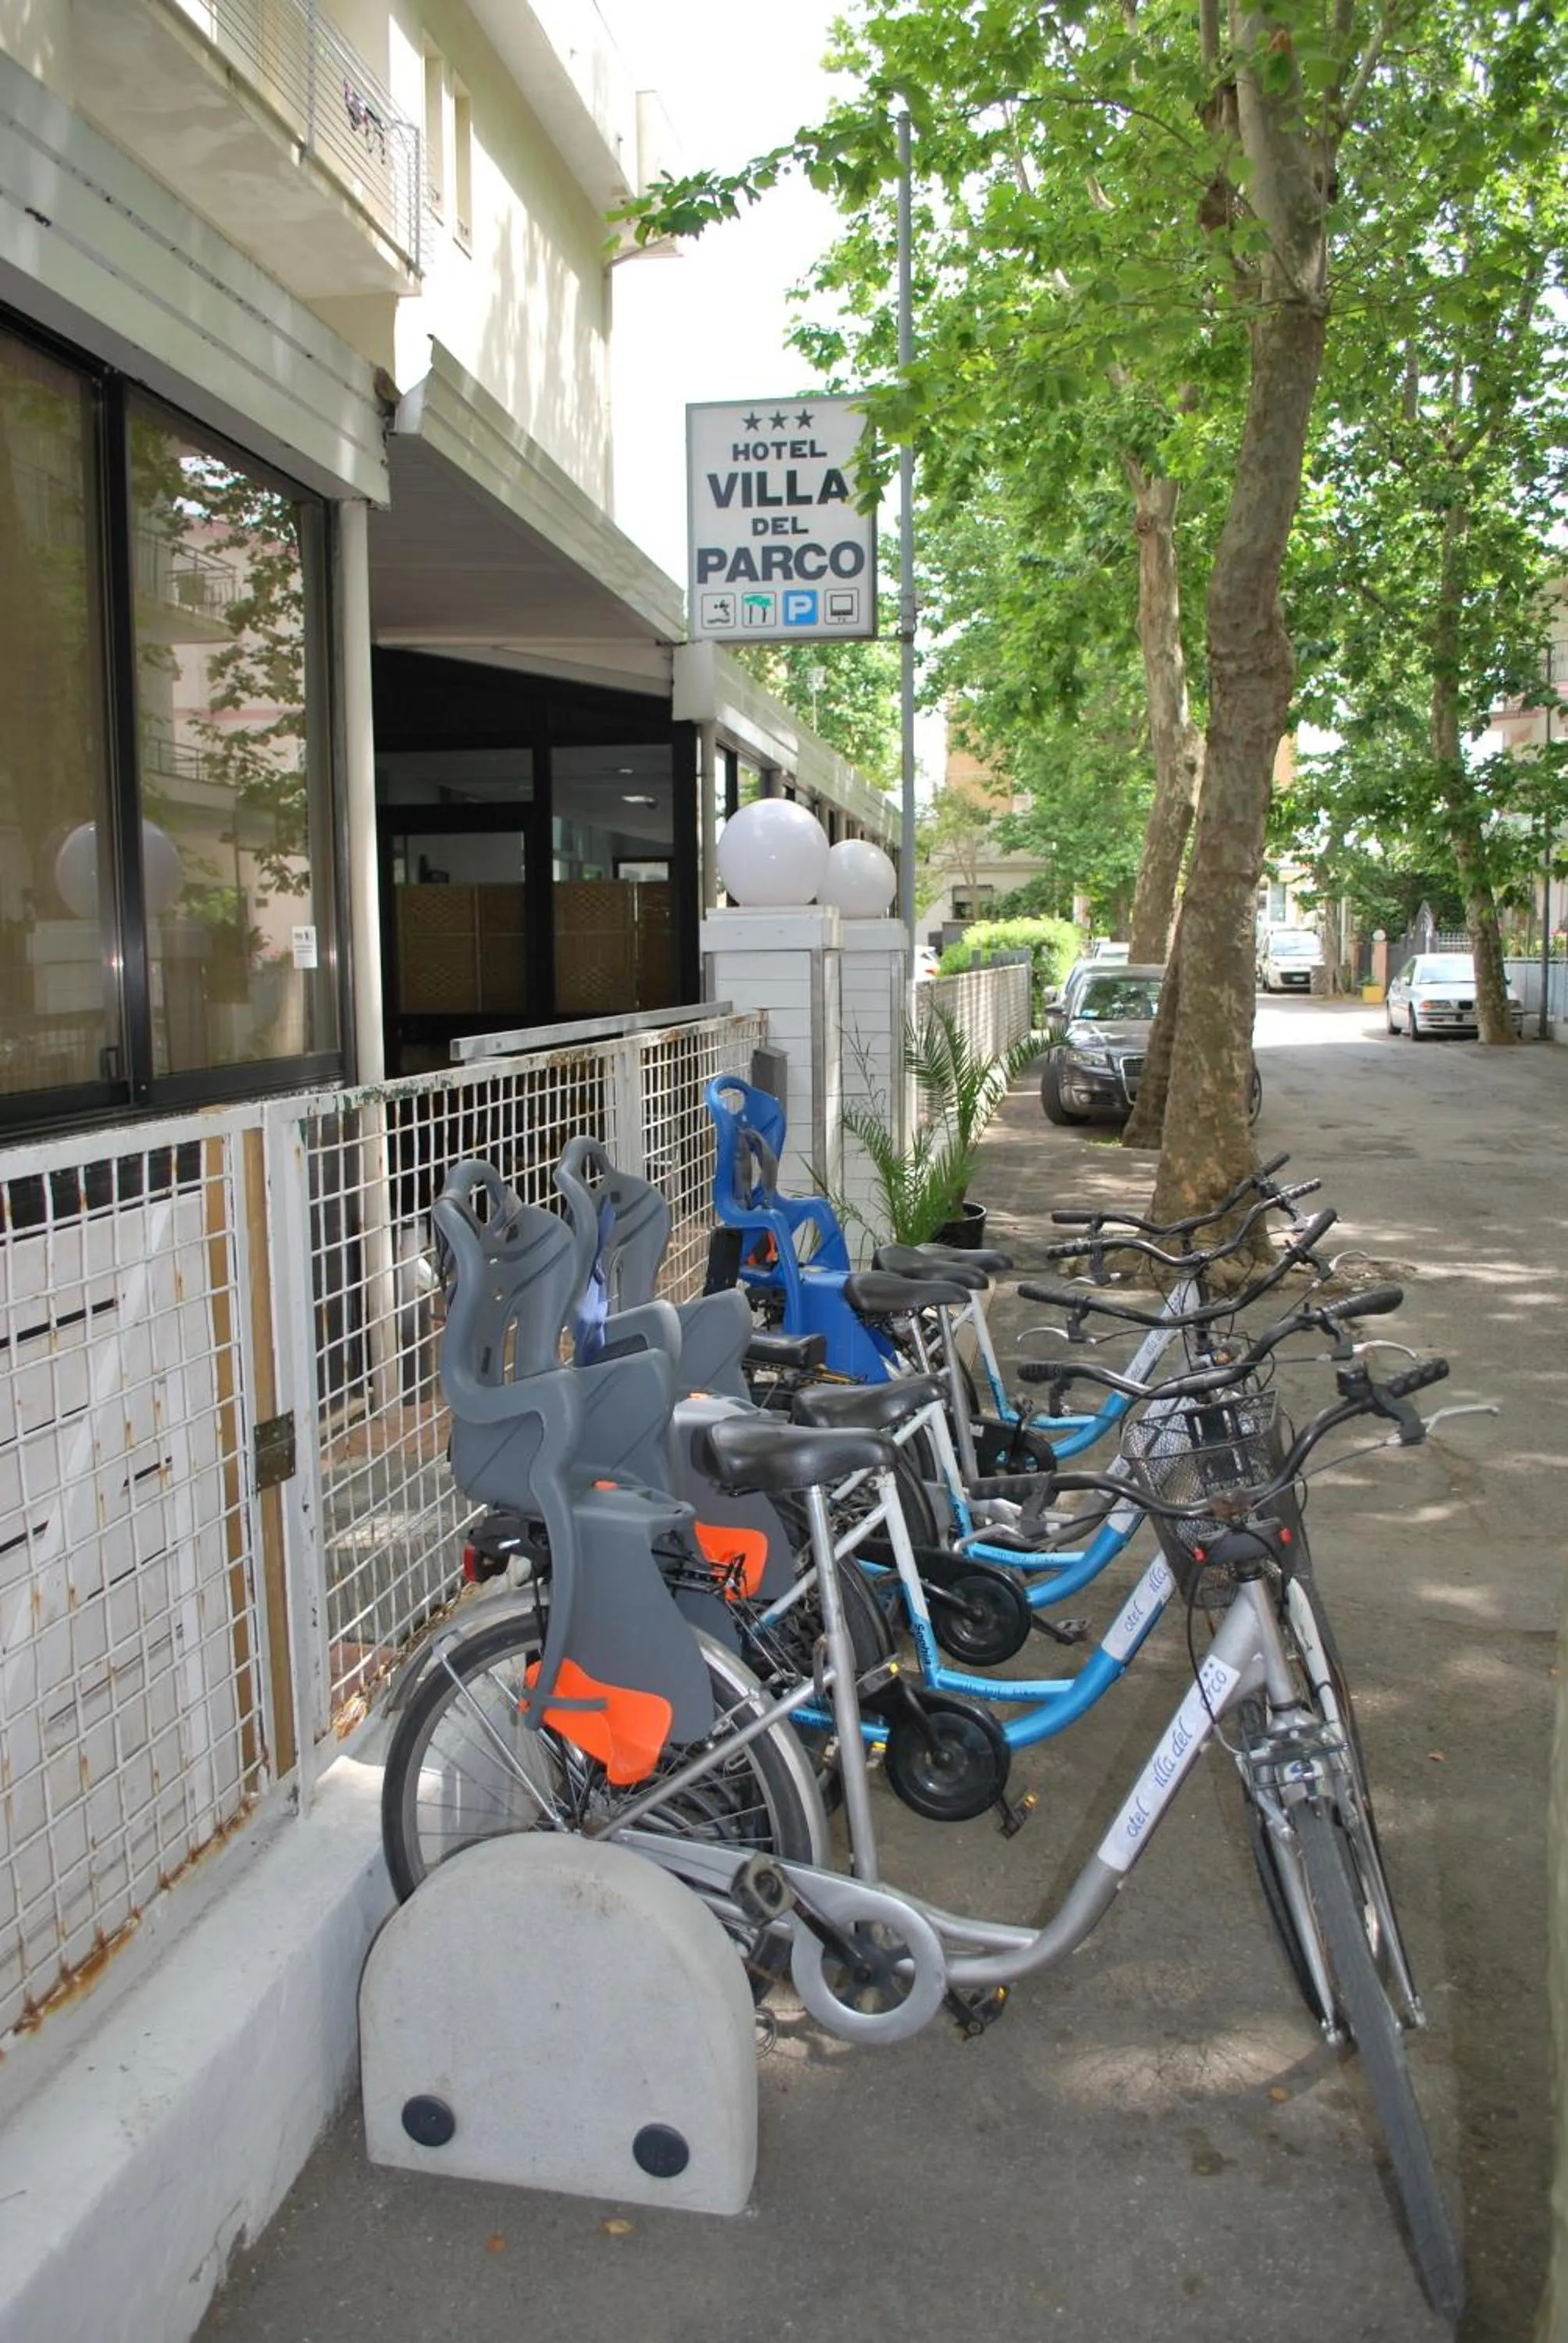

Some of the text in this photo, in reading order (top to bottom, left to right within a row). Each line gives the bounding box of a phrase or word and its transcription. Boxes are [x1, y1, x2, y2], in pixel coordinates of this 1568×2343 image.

[732, 440, 827, 462] HOTEL
[707, 469, 849, 509] VILLA
[752, 516, 809, 536] DEL
[697, 540, 864, 584] PARCO
[789, 594, 813, 621] P
[1171, 1716, 1192, 1755] del
